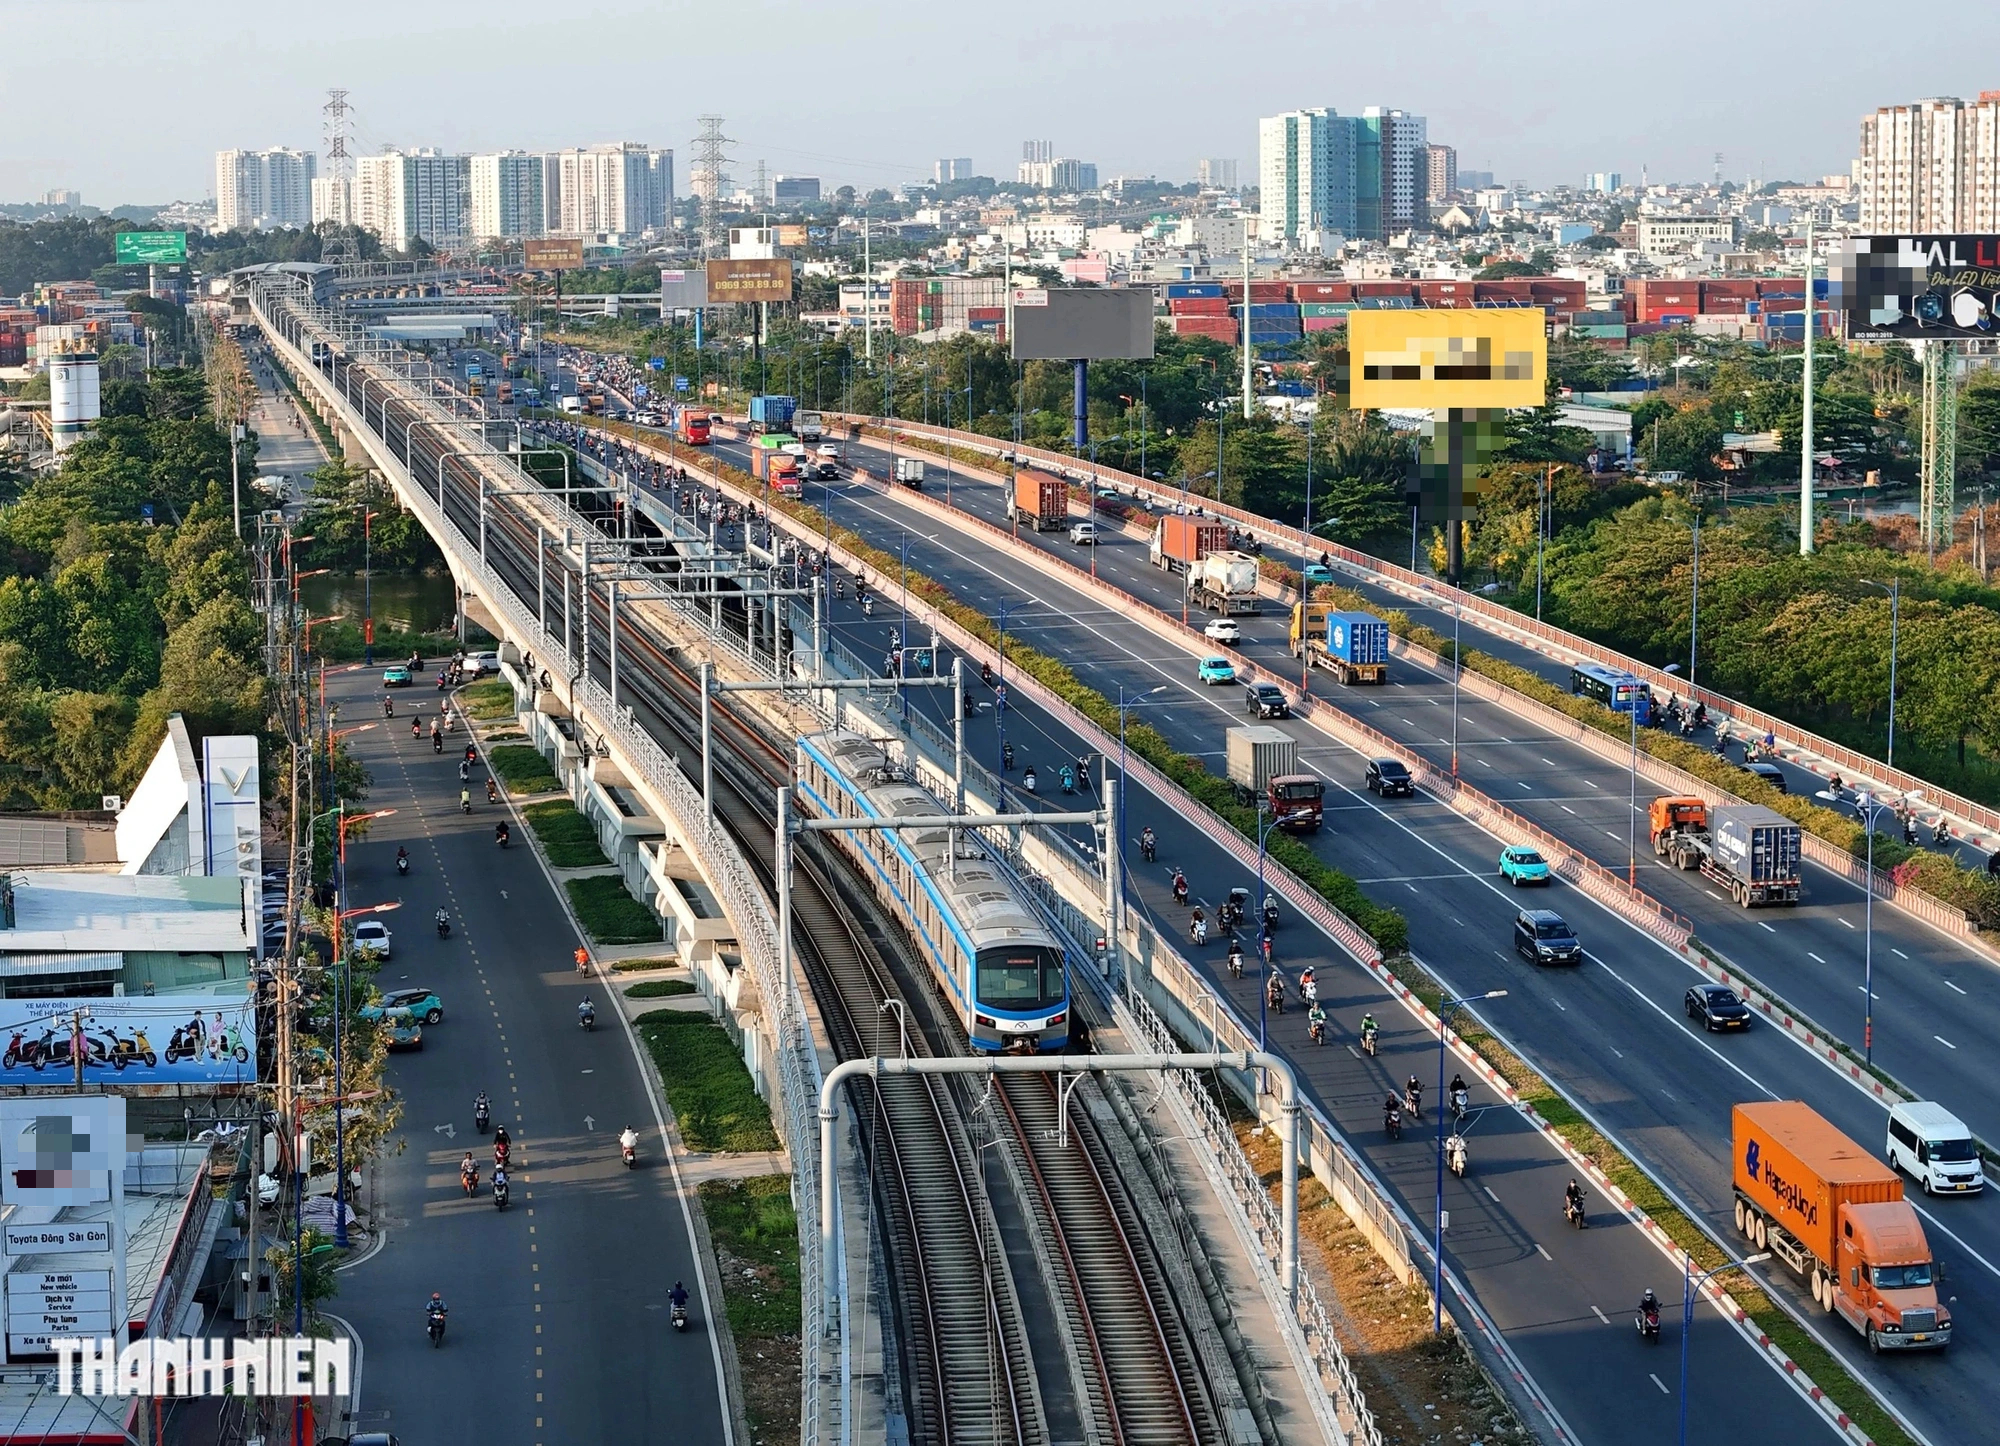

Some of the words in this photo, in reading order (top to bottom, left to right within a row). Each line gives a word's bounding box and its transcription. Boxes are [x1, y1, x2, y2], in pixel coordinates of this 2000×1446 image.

[715, 280, 784, 290] 0969.39.89.89
[1764, 1160, 1818, 1226] Hapag-Lloyd
[8, 1234, 38, 1245] Toyota
[41, 1233, 64, 1244] Đông
[68, 1232, 84, 1242] Sài
[87, 1231, 106, 1240] Gòn
